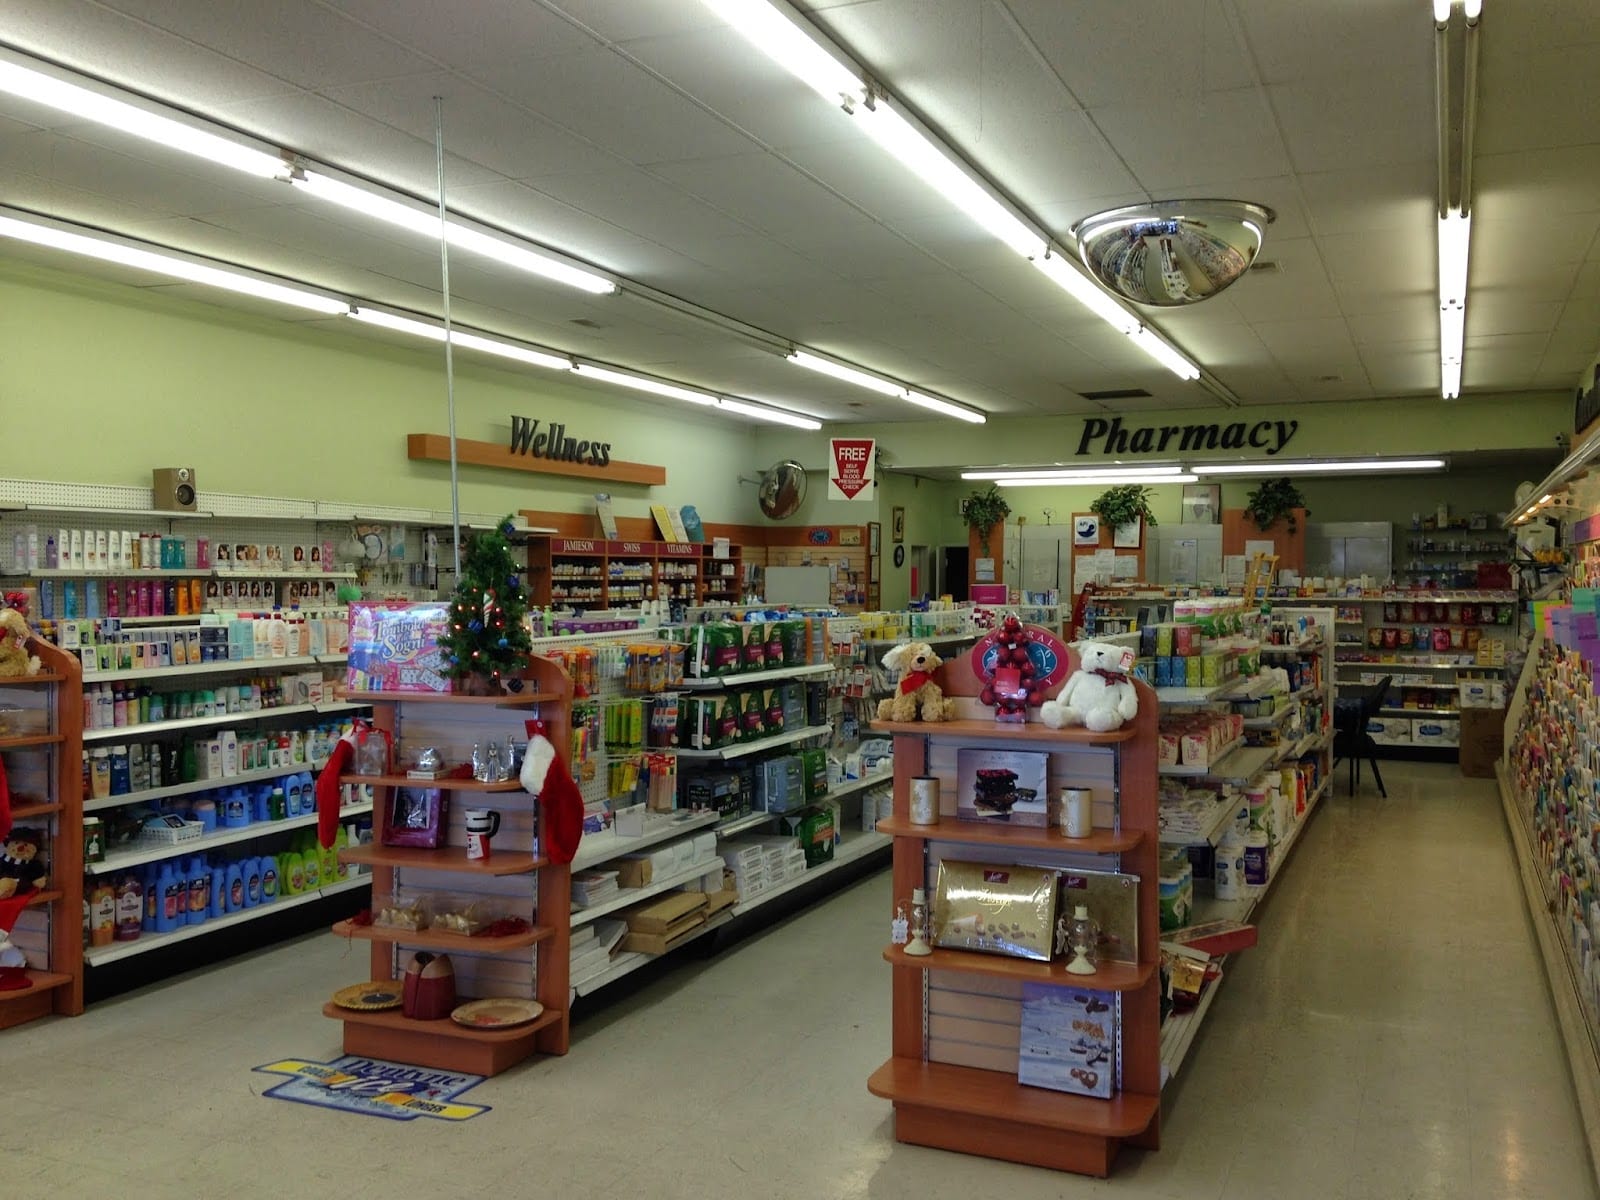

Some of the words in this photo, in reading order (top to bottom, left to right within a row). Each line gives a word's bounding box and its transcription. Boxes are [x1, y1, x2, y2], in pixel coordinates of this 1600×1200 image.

[510, 415, 611, 467] Wellness
[1074, 417, 1298, 455] Pharmacy
[838, 447, 866, 461] FREE
[563, 540, 594, 552] JAMIESON
[623, 542, 641, 553] SWISS
[666, 543, 693, 554] VITAMINS
[373, 618, 425, 642] Tombola
[382, 635, 426, 660] Sogni
[342, 1059, 467, 1087] Dentyne
[401, 1099, 448, 1114] LONGER
